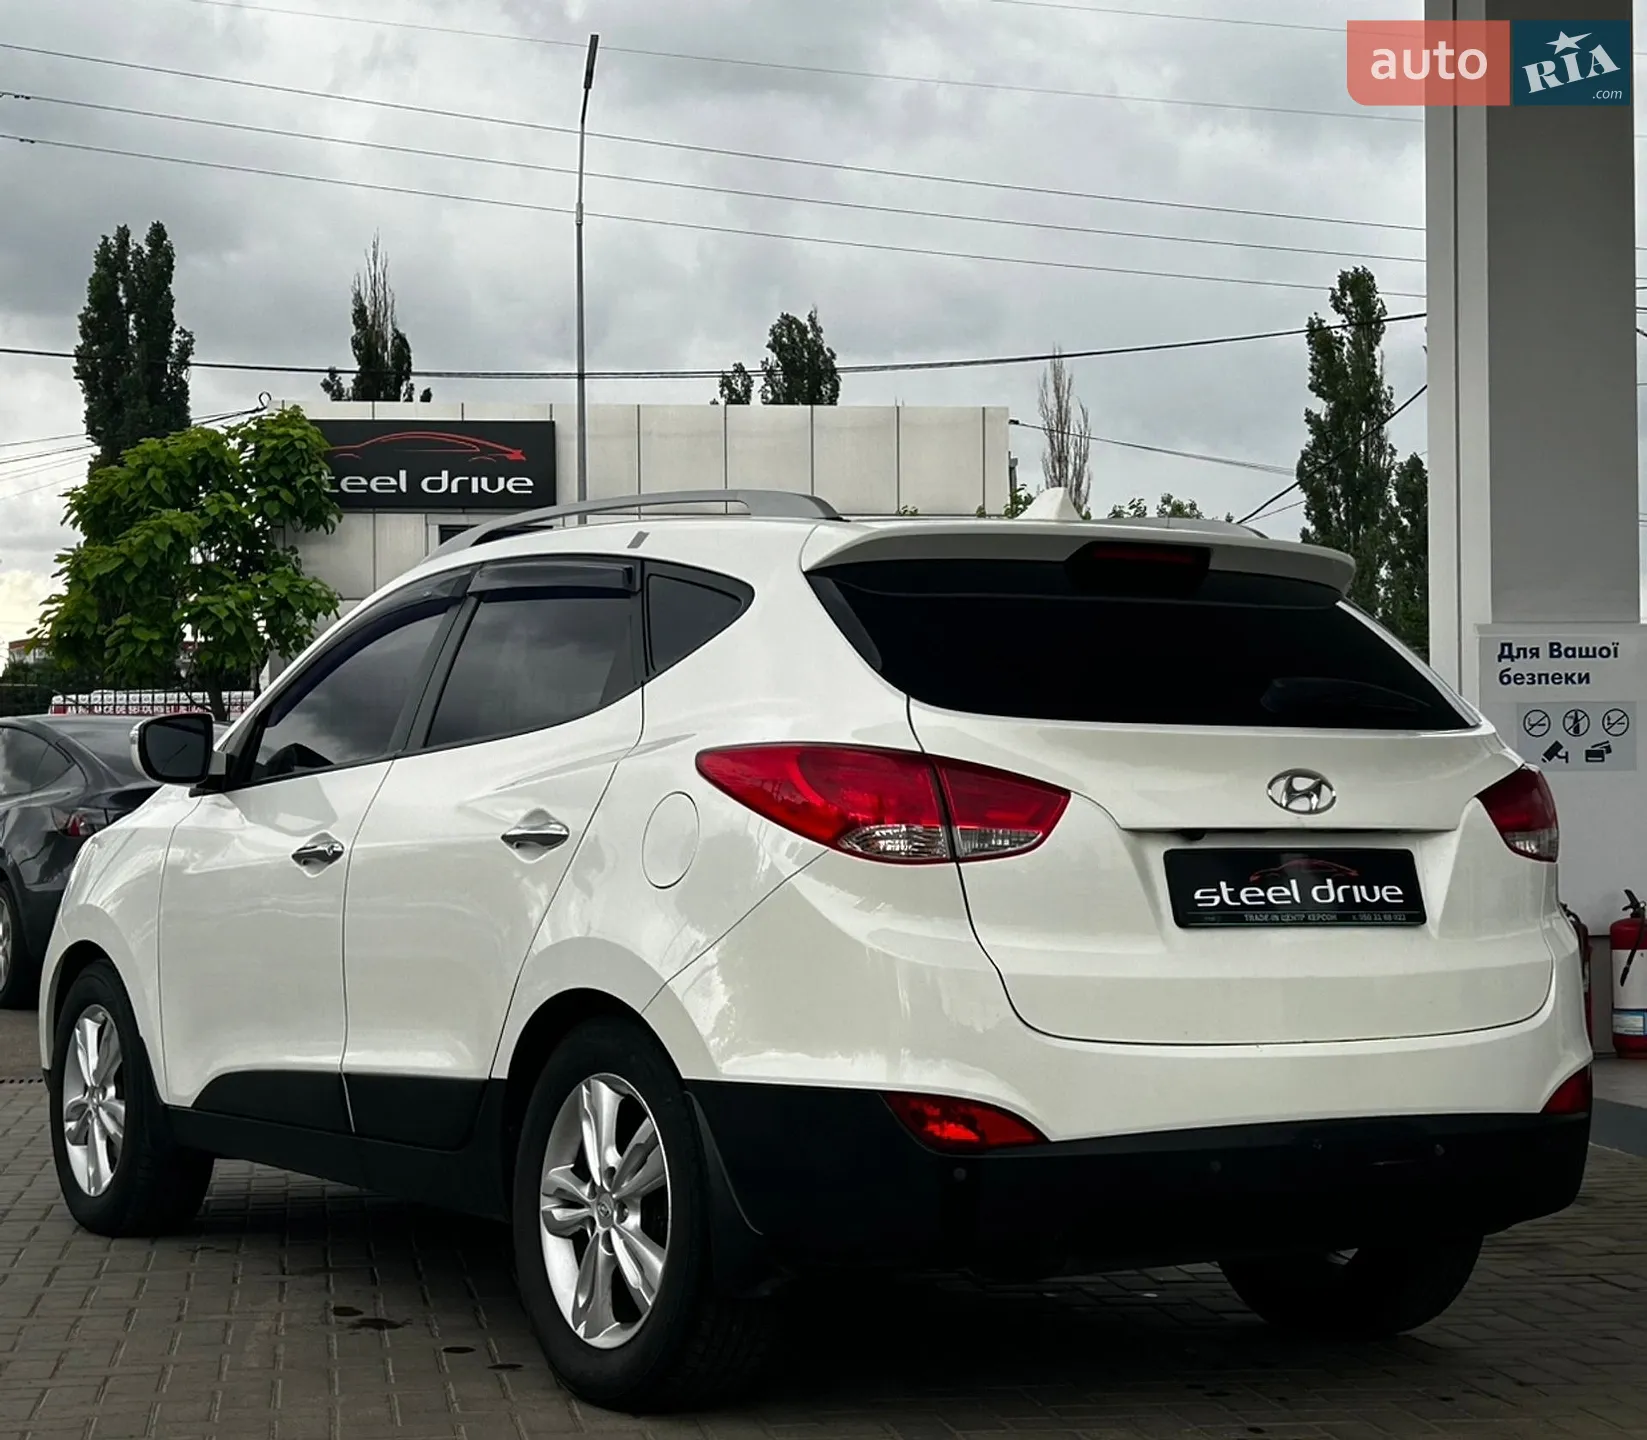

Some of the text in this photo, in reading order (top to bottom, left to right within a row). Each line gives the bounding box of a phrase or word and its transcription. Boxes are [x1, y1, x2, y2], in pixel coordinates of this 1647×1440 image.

[321, 469, 535, 494] teel drive
[1497, 641, 1620, 662] Для Вашої
[1498, 667, 1591, 686] безпеки
[1193, 878, 1404, 907] steel drive
